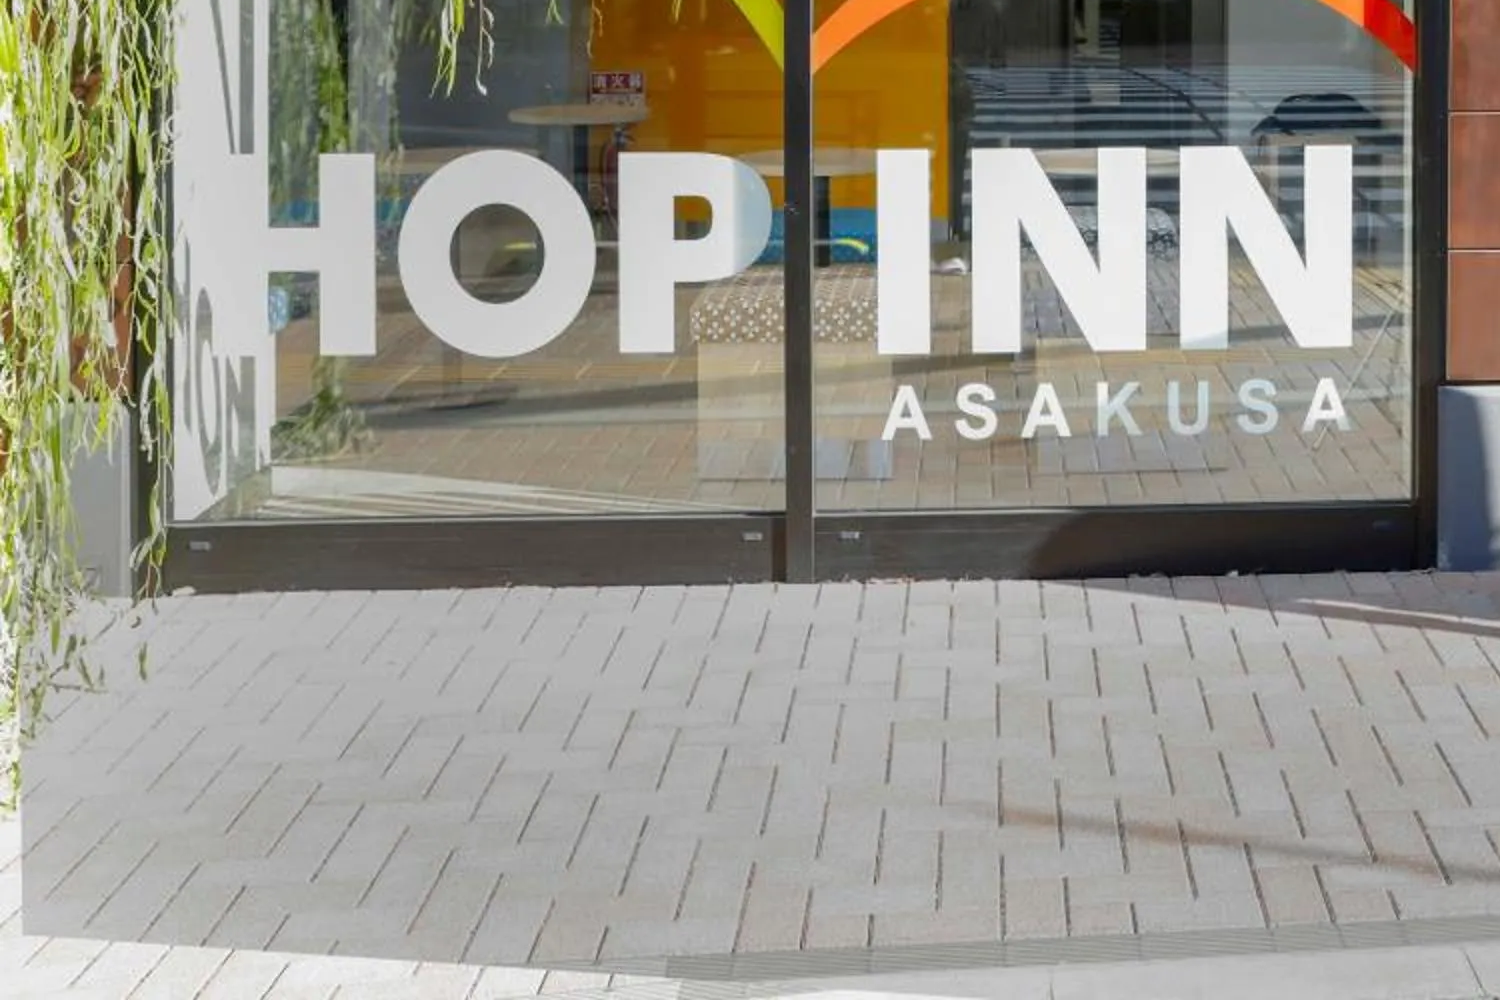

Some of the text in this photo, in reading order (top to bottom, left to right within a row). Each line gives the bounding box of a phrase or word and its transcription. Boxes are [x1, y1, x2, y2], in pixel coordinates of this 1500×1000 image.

[212, 144, 1353, 357] HOP INN
[881, 376, 1352, 441] ASAKUSA
